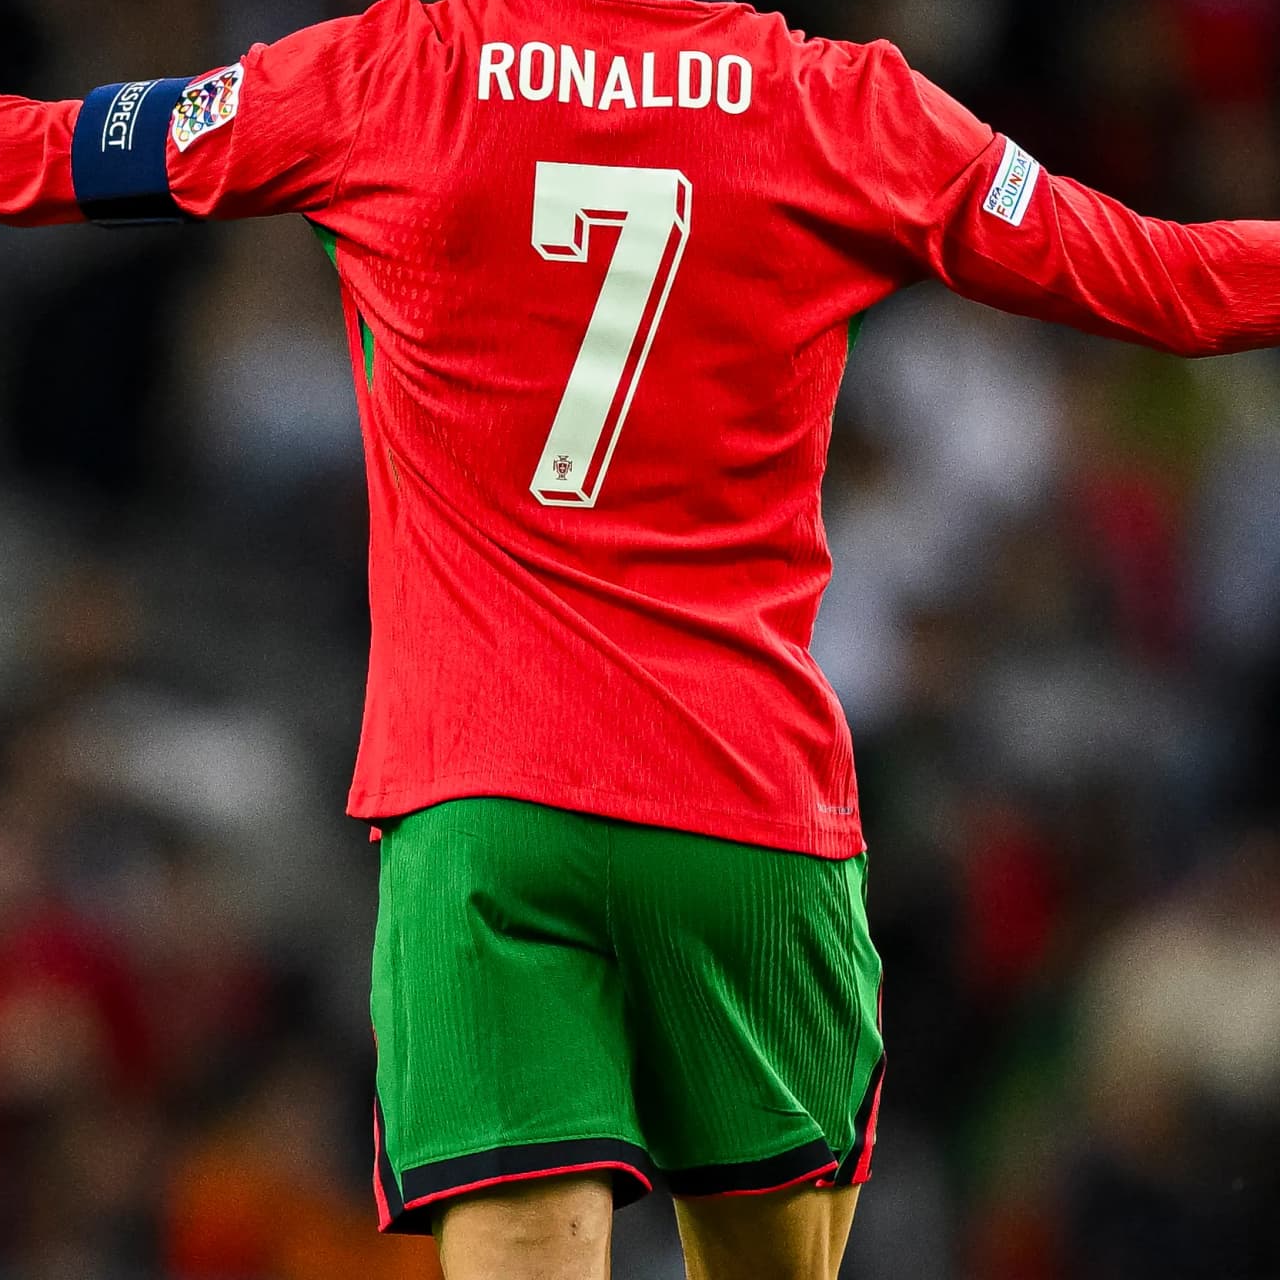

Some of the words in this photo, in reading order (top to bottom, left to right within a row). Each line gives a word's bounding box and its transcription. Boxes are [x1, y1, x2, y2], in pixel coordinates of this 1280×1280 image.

[477, 41, 753, 115] RONALDO
[986, 186, 1003, 211] UEFA
[529, 161, 692, 509] 7
